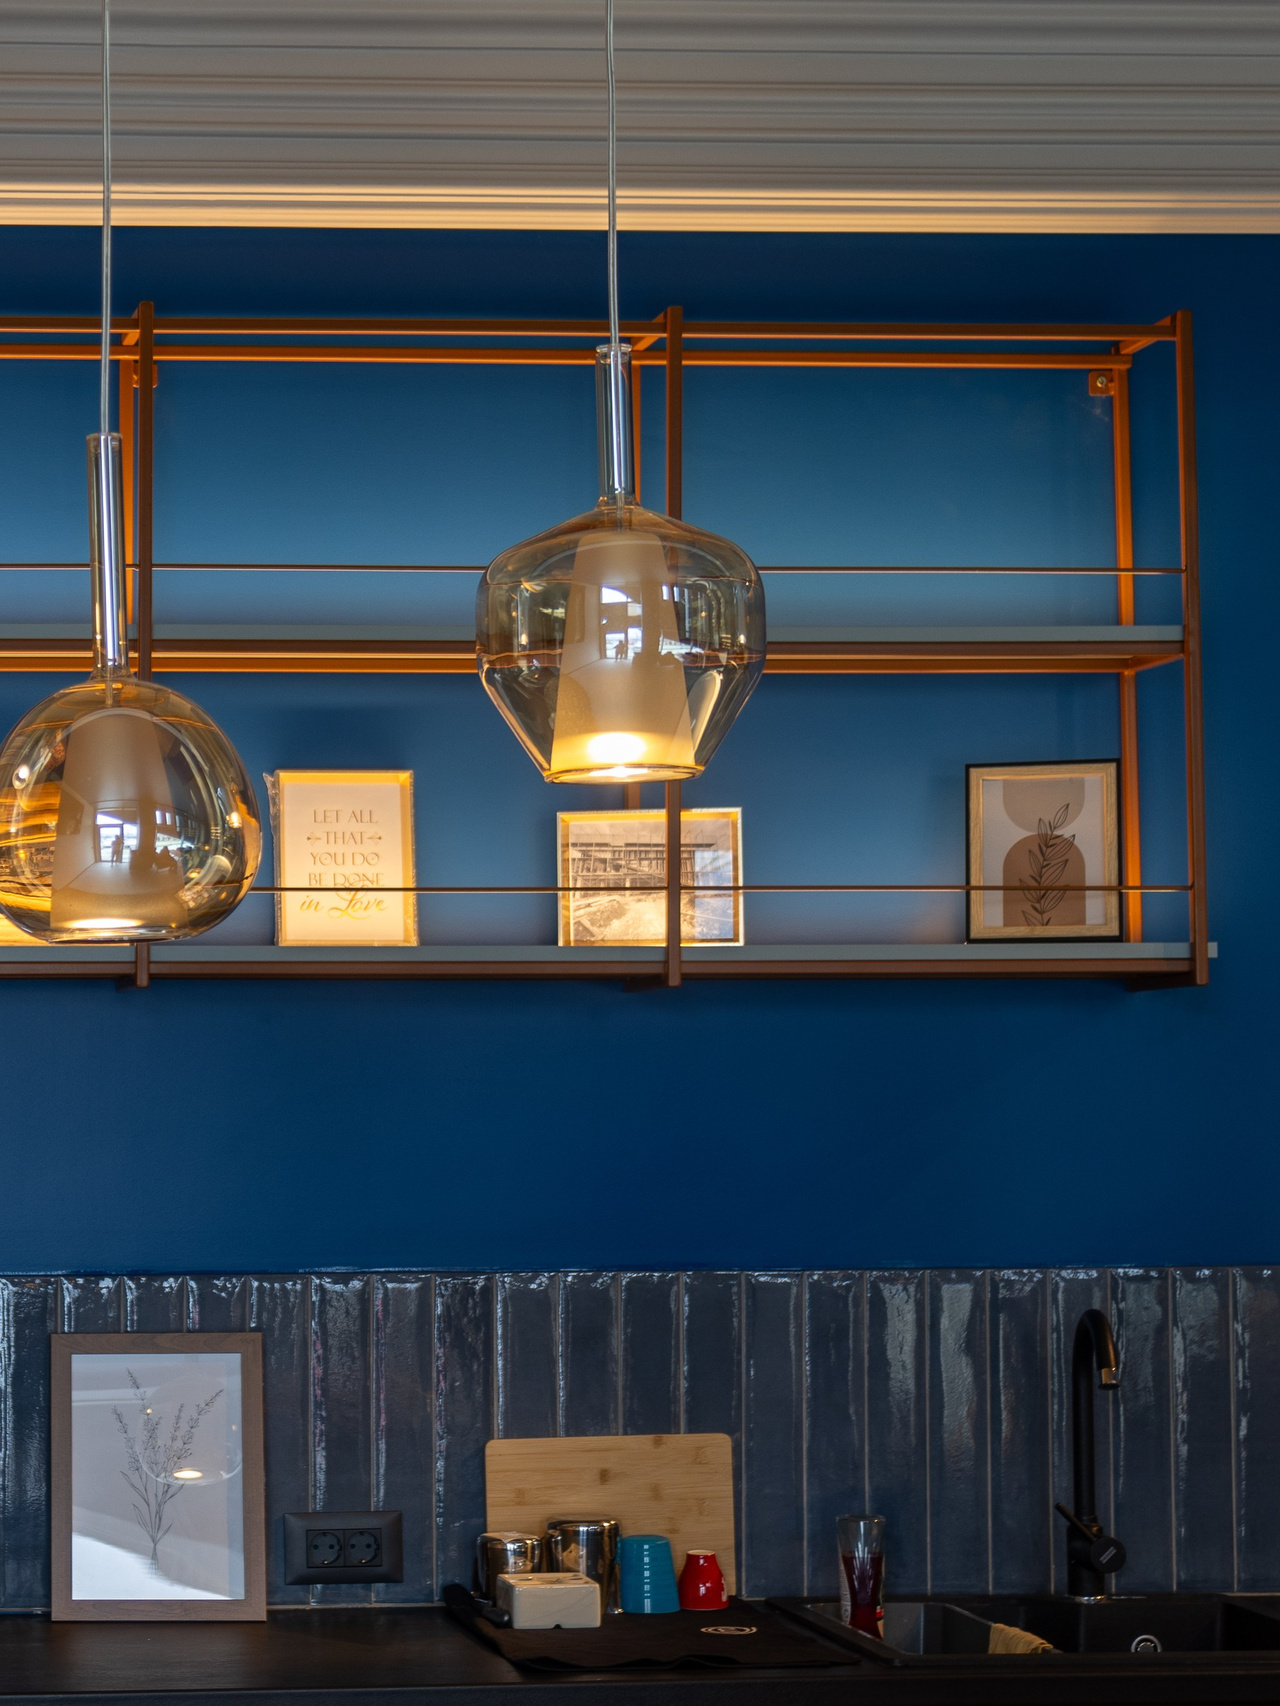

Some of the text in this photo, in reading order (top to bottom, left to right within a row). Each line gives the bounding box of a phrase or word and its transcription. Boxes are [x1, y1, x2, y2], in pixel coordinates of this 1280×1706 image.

[313, 811, 378, 824] LET ALL
[324, 831, 367, 845] THAT
[310, 852, 380, 866] YOU DO
[308, 873, 385, 887] BE DONE
[300, 880, 388, 919] in Love
